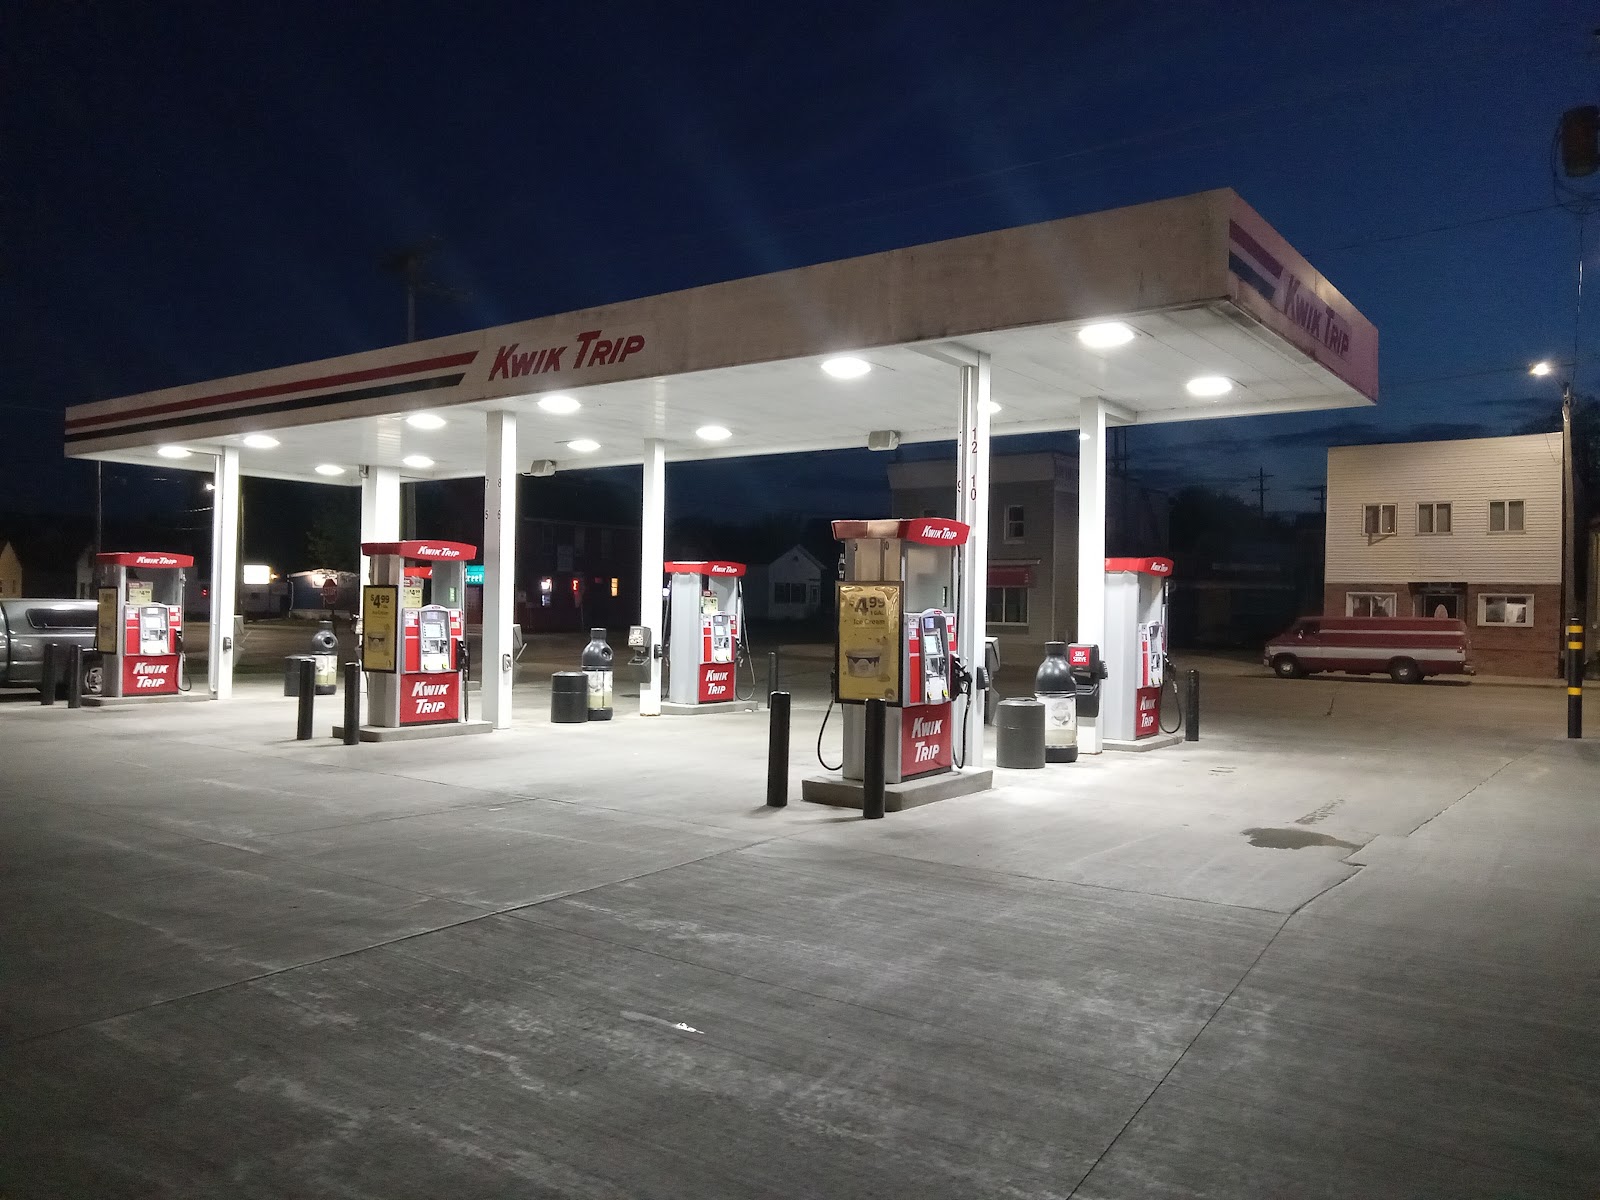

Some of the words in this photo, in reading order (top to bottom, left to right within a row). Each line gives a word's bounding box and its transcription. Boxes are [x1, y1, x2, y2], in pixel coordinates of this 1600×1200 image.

[488, 343, 568, 381] KWIK
[573, 330, 645, 369] TRIP
[922, 525, 942, 538] KWIK
[941, 527, 957, 540] TRIP
[417, 546, 441, 555] KWIK
[440, 547, 459, 557] TRIP
[133, 662, 169, 675] KWIK
[706, 670, 728, 681] KWIK
[136, 676, 165, 688] TRIP
[412, 681, 449, 697] KWIK
[708, 683, 726, 695] TRIP
[415, 699, 446, 714] TRIP
[911, 717, 942, 738] KWIK
[915, 741, 940, 762] TRIP
